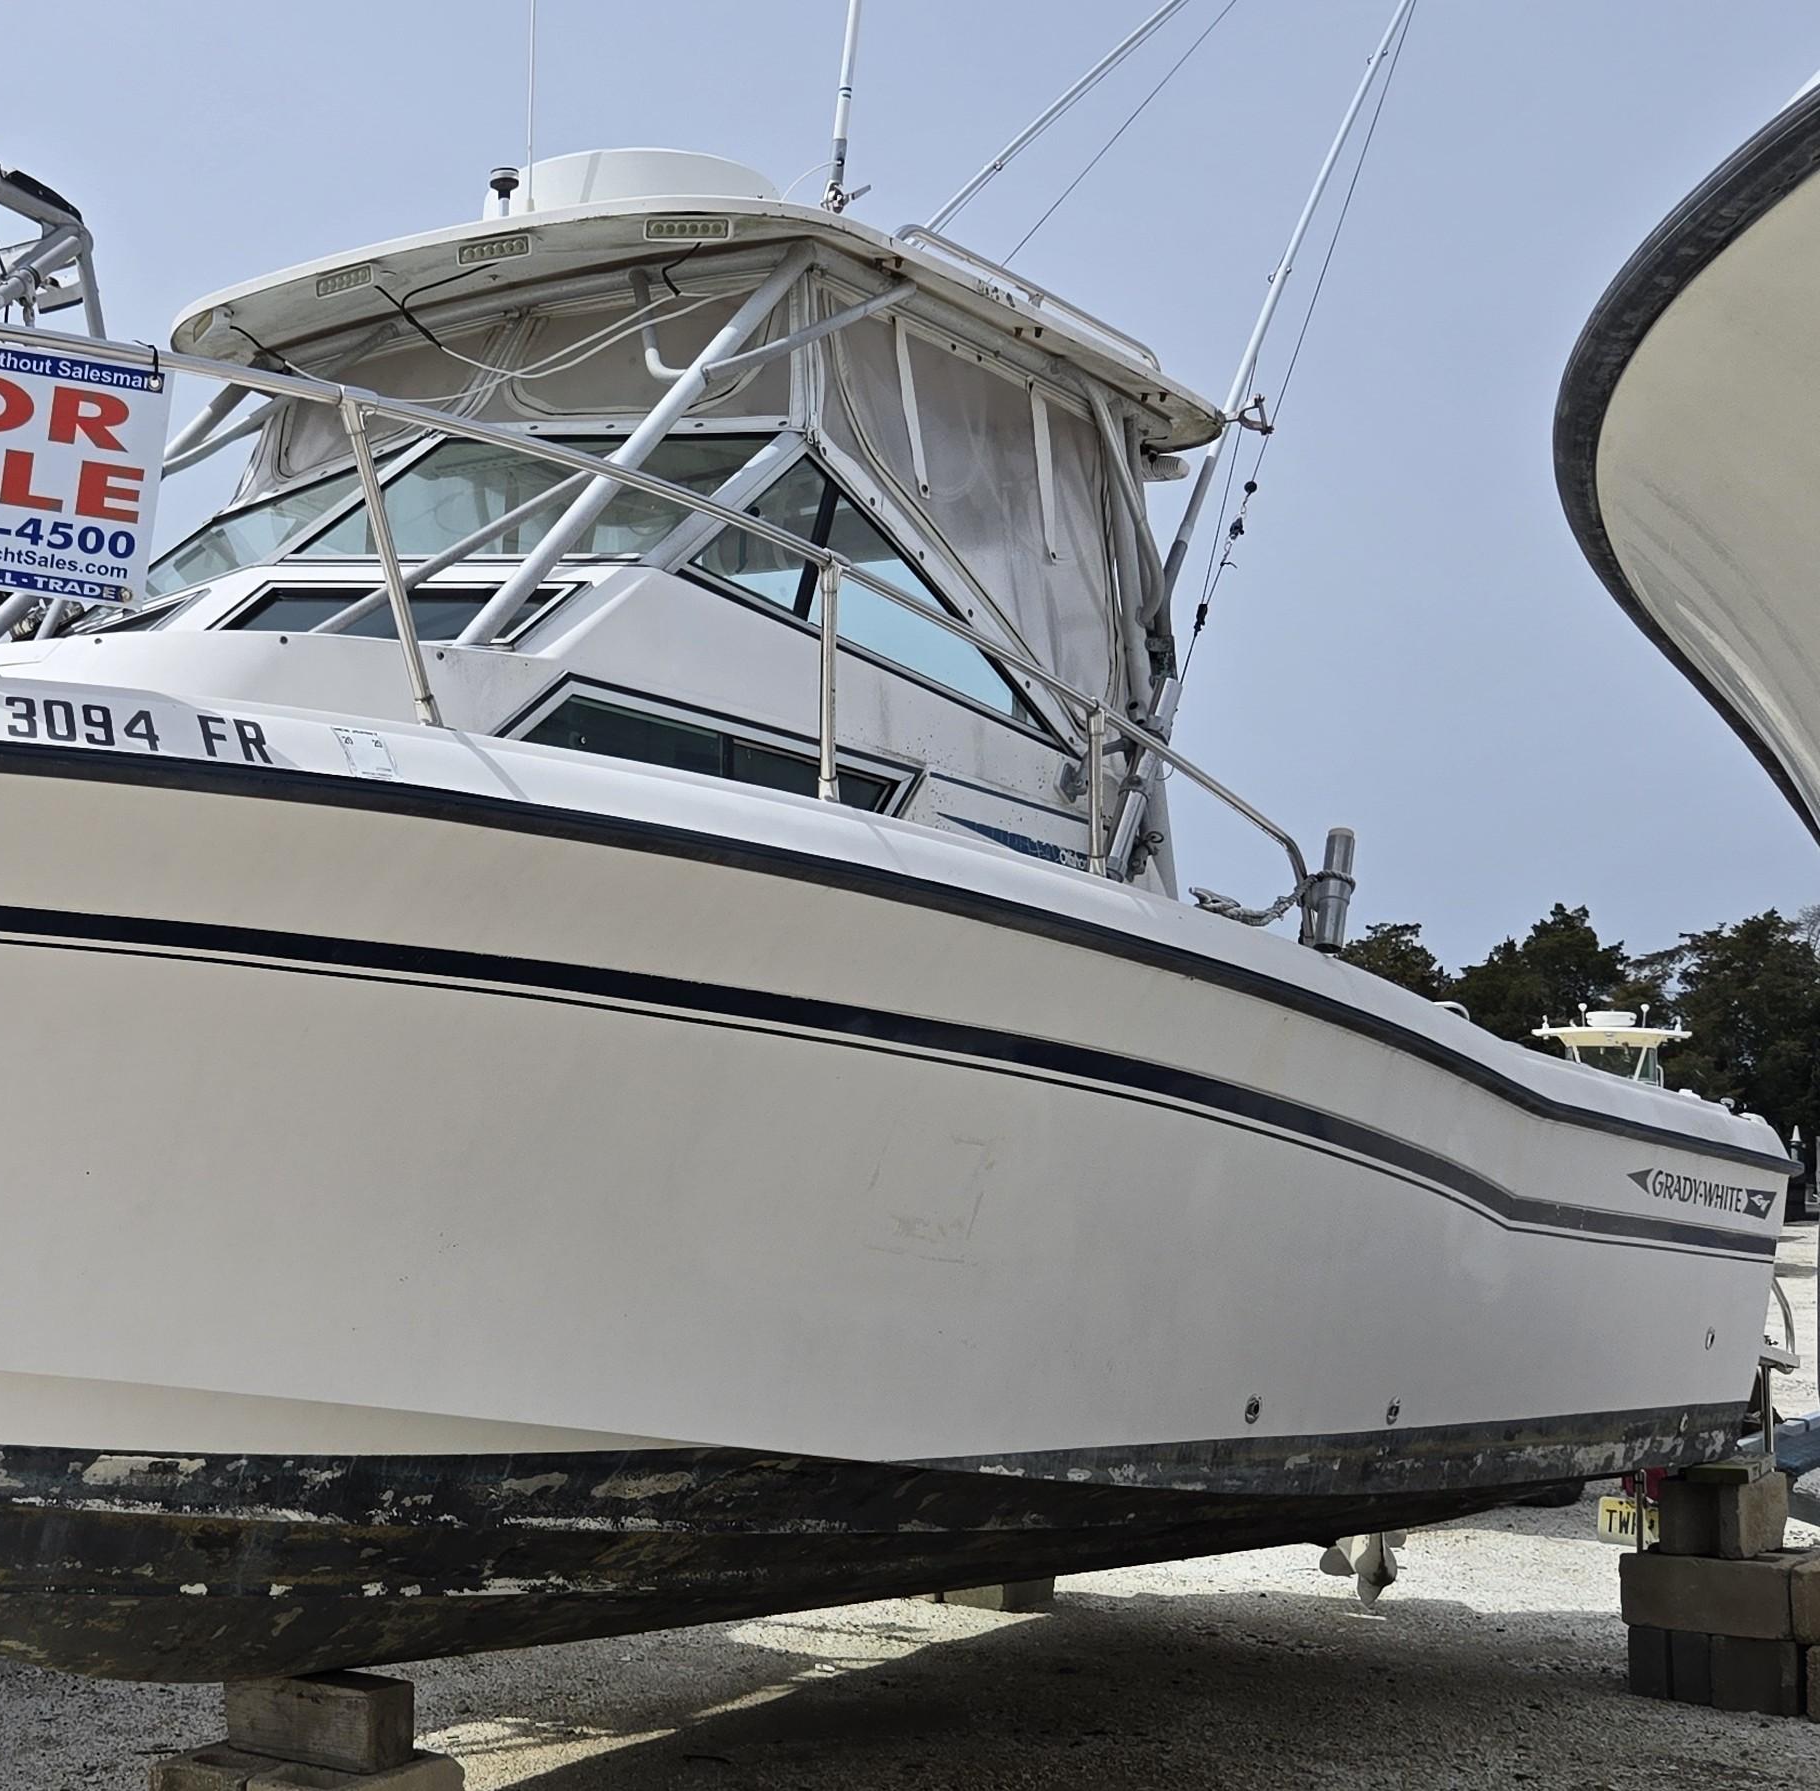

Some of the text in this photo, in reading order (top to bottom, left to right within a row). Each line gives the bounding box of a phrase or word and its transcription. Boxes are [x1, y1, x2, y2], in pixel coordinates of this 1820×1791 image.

[34, 576, 116, 600] TRADE
[5, 696, 160, 751] 3094
[197, 714, 273, 764] FR
